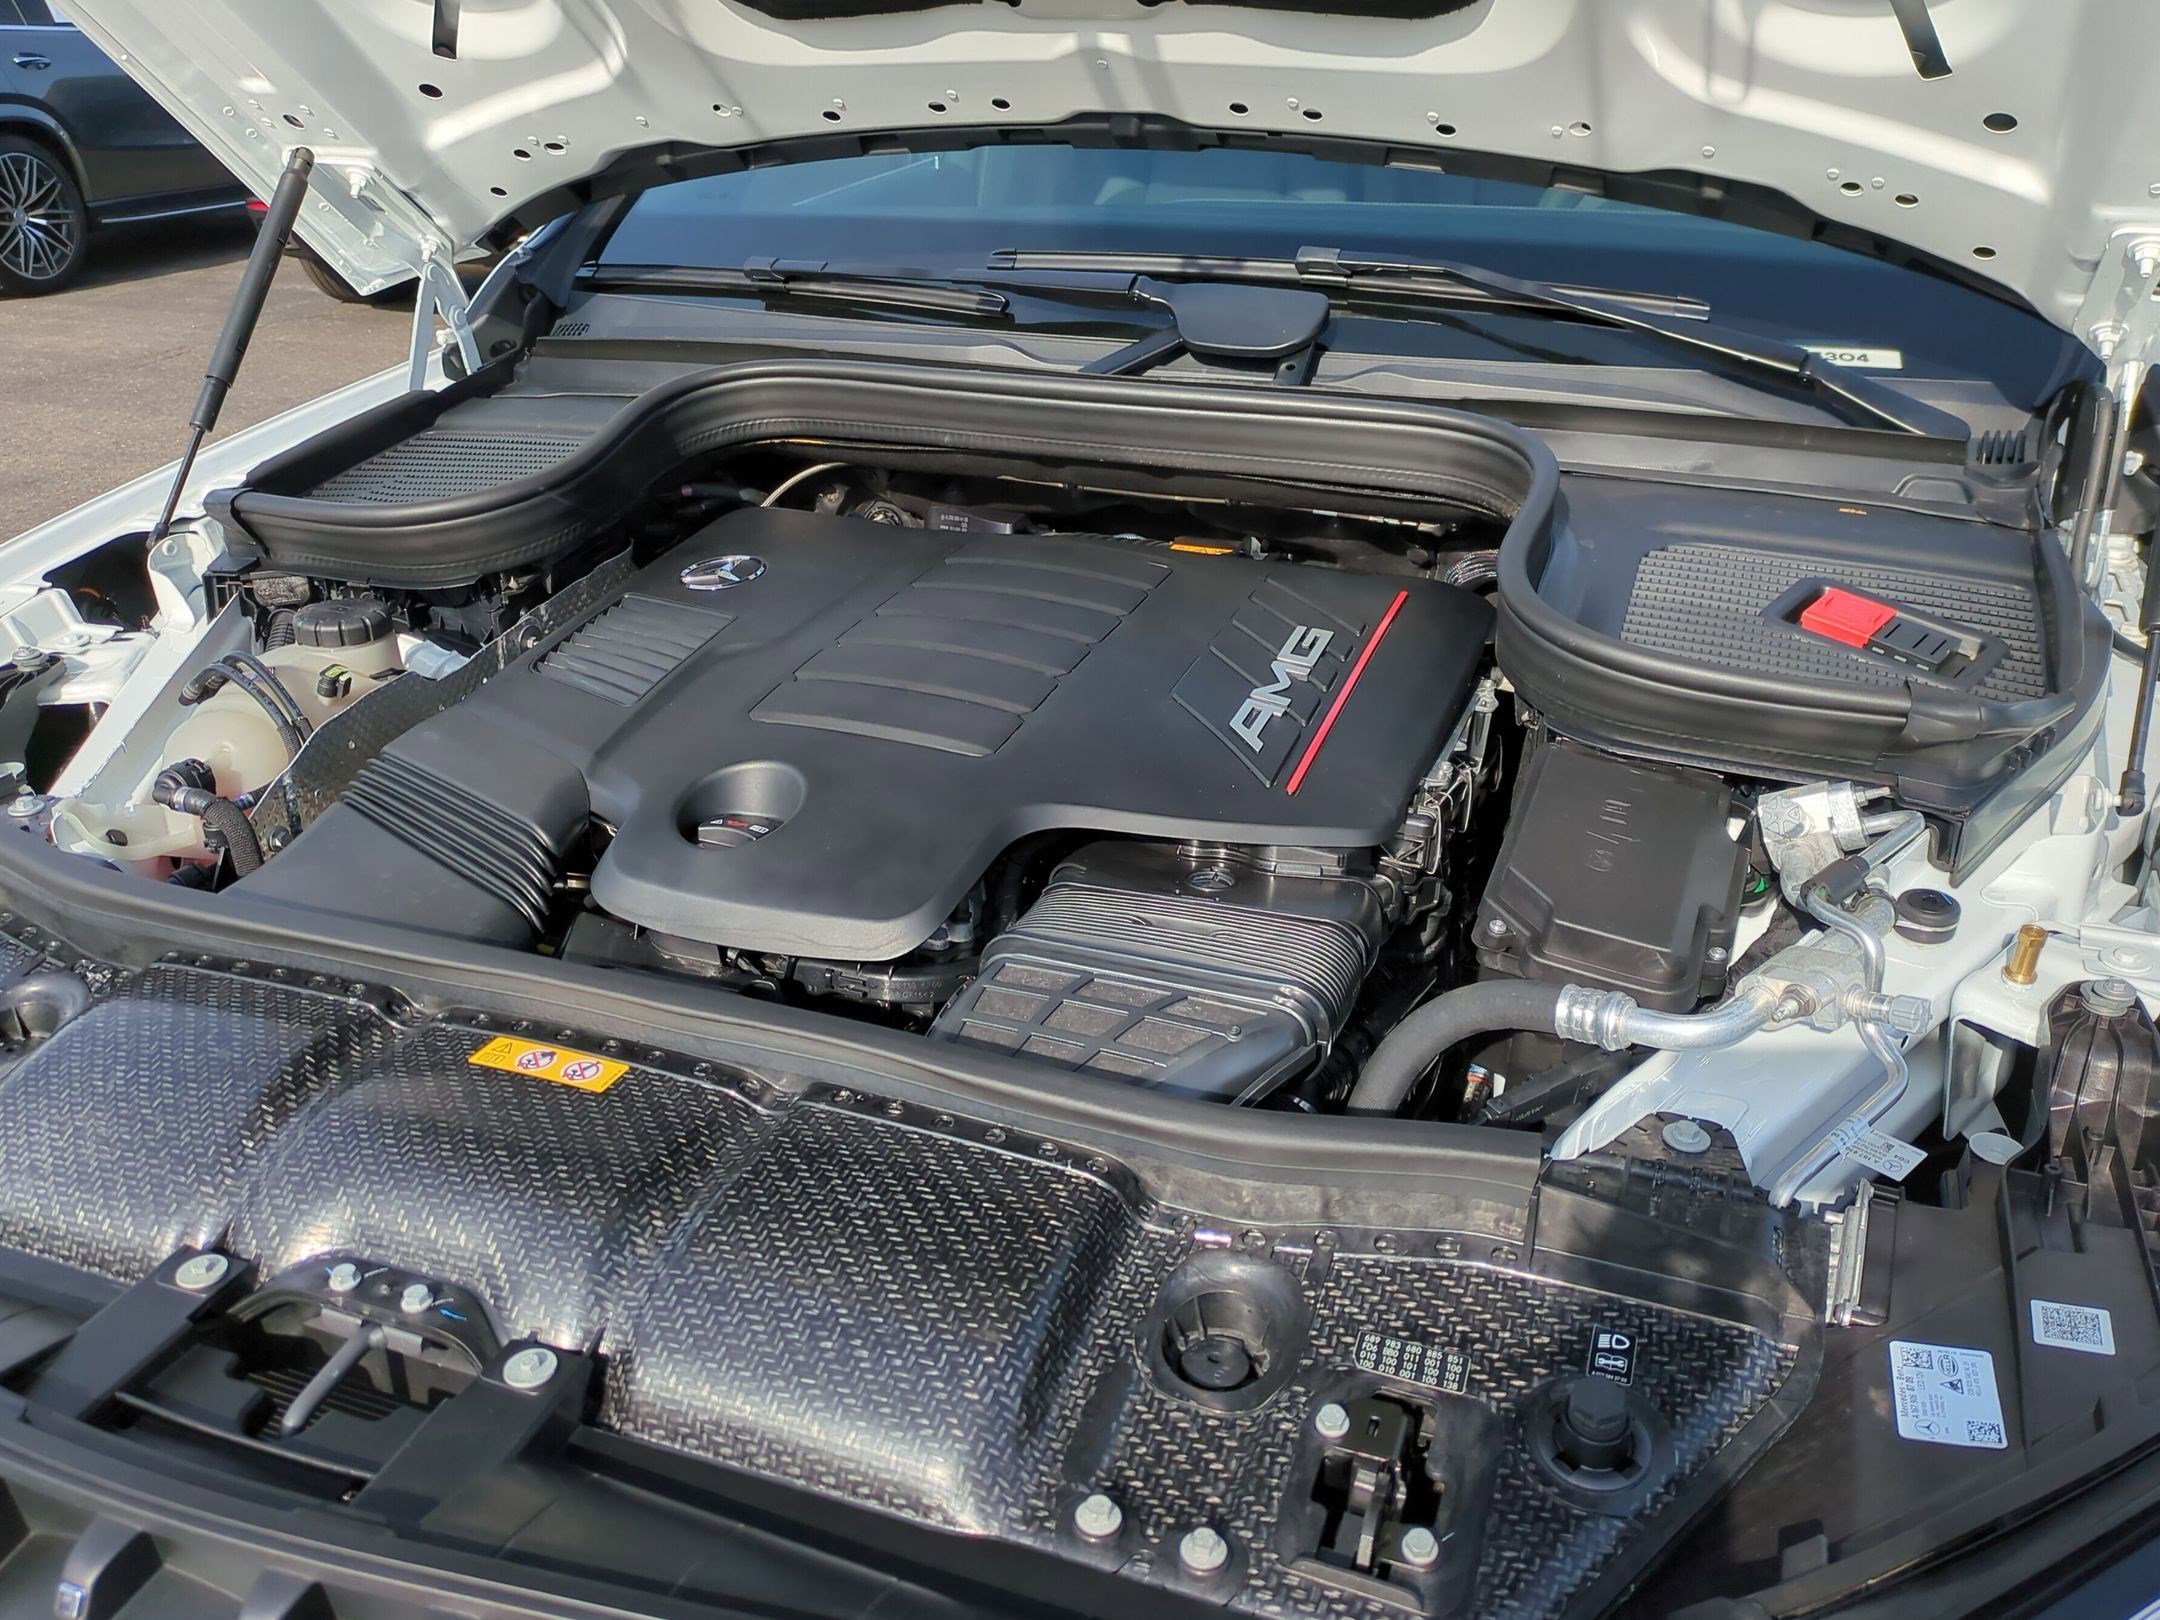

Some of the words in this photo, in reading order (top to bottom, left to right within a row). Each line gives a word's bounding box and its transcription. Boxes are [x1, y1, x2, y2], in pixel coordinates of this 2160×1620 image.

[1229, 625, 1335, 754] AMG
[1361, 1342, 1378, 1353] FD6
[1403, 1352, 1420, 1363] 011
[1424, 1357, 1440, 1368] 001
[1446, 1363, 1462, 1373] 100
[1364, 1334, 1381, 1344] 689
[1385, 1339, 1402, 1350] 983
[1405, 1344, 1422, 1355] 680
[1359, 1350, 1377, 1361] 010
[1382, 1356, 1398, 1366] 100
[1402, 1361, 1418, 1371] 101
[1423, 1366, 1439, 1377] 100
[1444, 1371, 1459, 1381] 101
[1359, 1360, 1375, 1370] 100
[1378, 1364, 1395, 1375] 010
[1399, 1370, 1415, 1380] 001
[1422, 1375, 1438, 1385] 100
[1443, 1380, 1459, 1390] 138
[1943, 1354, 1952, 1375] HELLA
